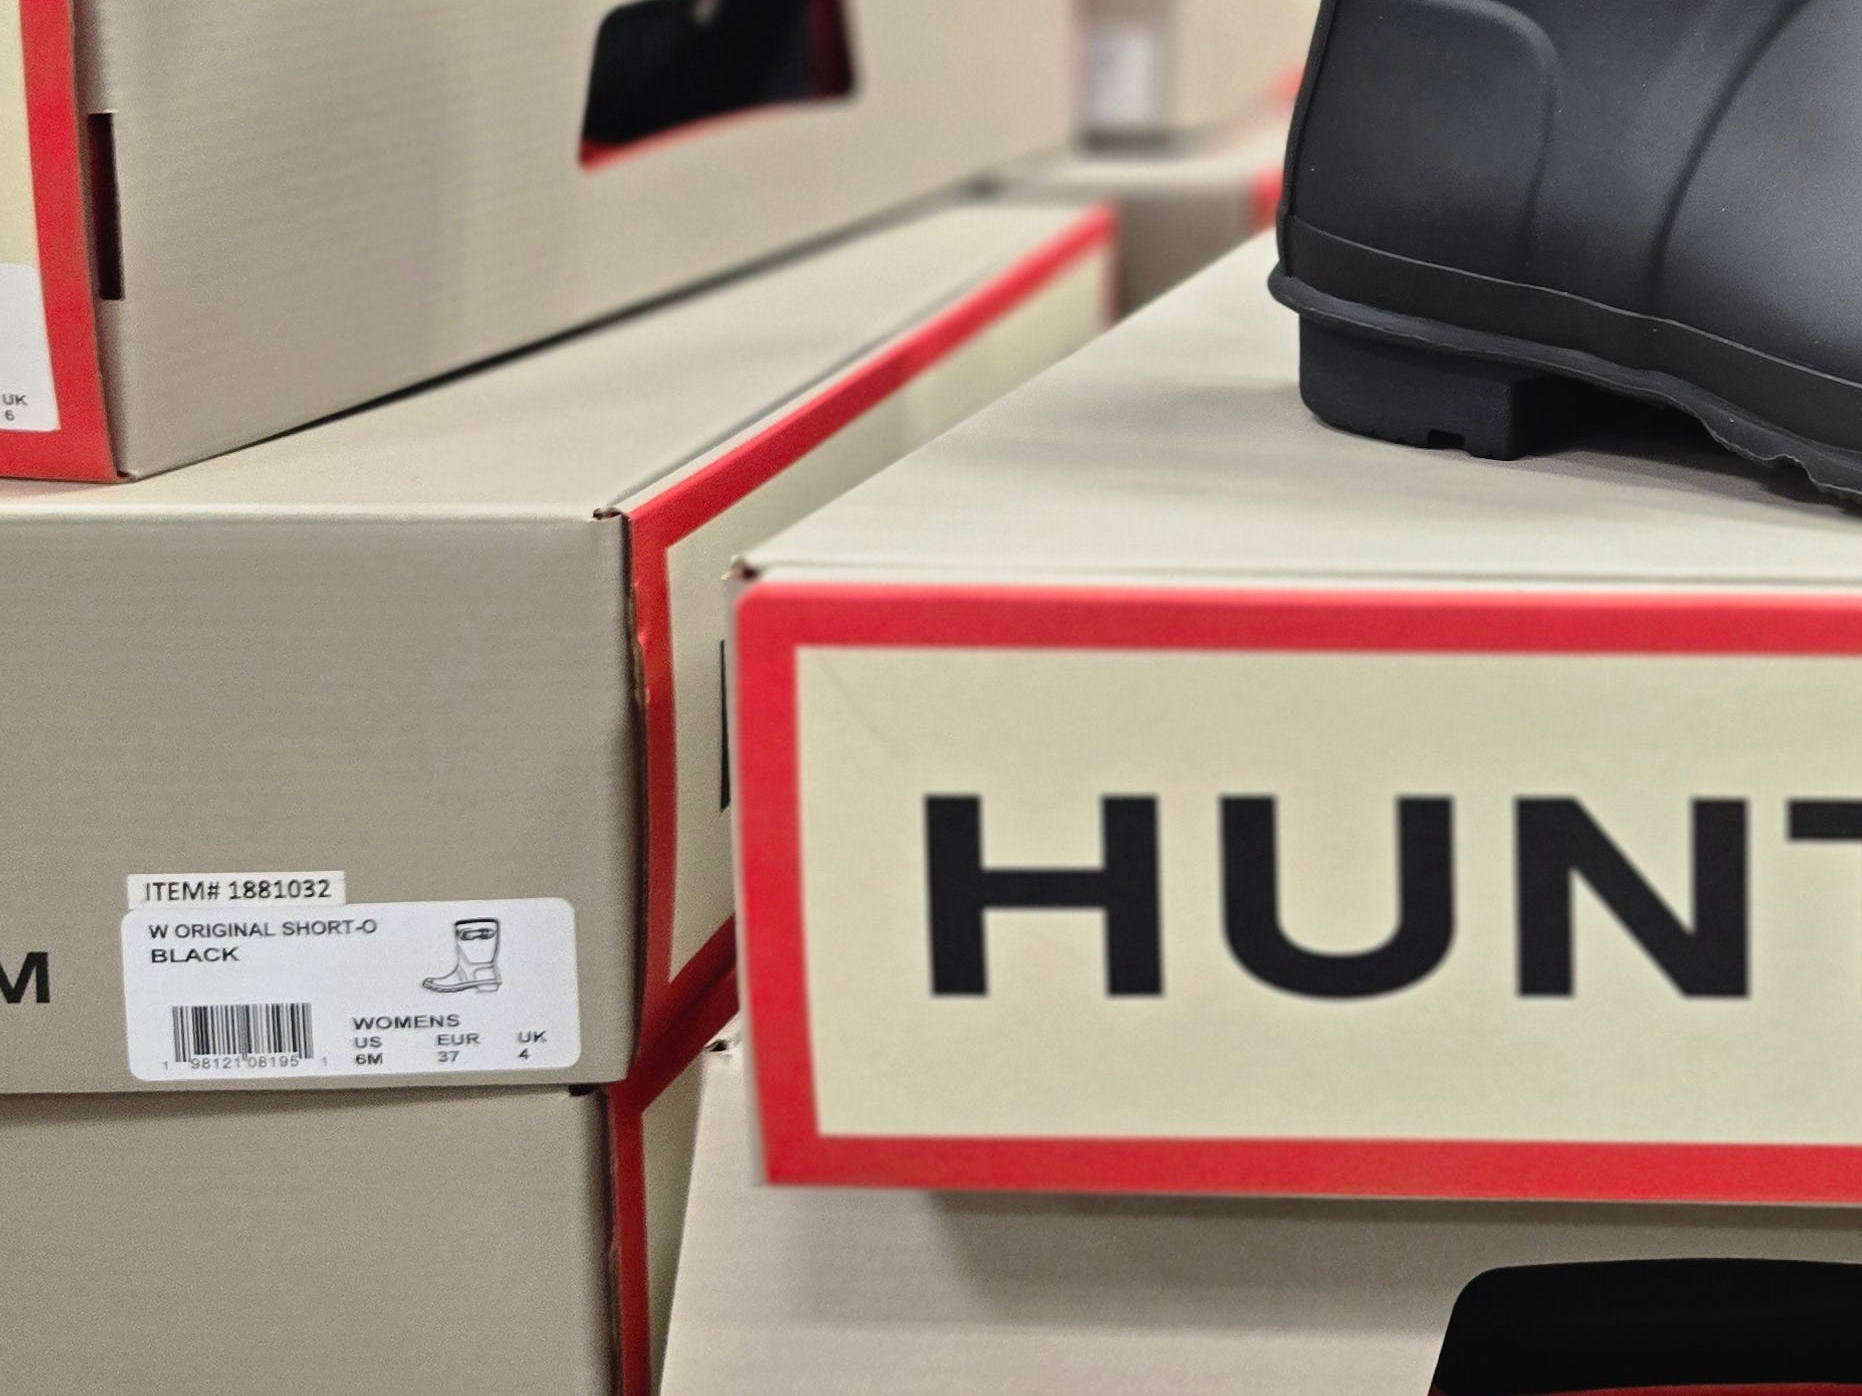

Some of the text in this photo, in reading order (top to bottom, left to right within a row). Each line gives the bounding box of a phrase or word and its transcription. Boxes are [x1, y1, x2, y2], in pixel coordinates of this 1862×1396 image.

[2, 393, 28, 406] UK
[4, 409, 15, 421] 6
[145, 878, 333, 903] ITEM# 1881032
[148, 918, 378, 939] W ORIGINAL SHORT-O
[150, 946, 240, 965] BLACK
[353, 1014, 461, 1031] WOMENS
[353, 1030, 548, 1049] US EUR UK
[190, 1057, 241, 1070] 98121
[247, 1054, 300, 1068] 08195
[354, 1047, 531, 1066] 6M 37 4
